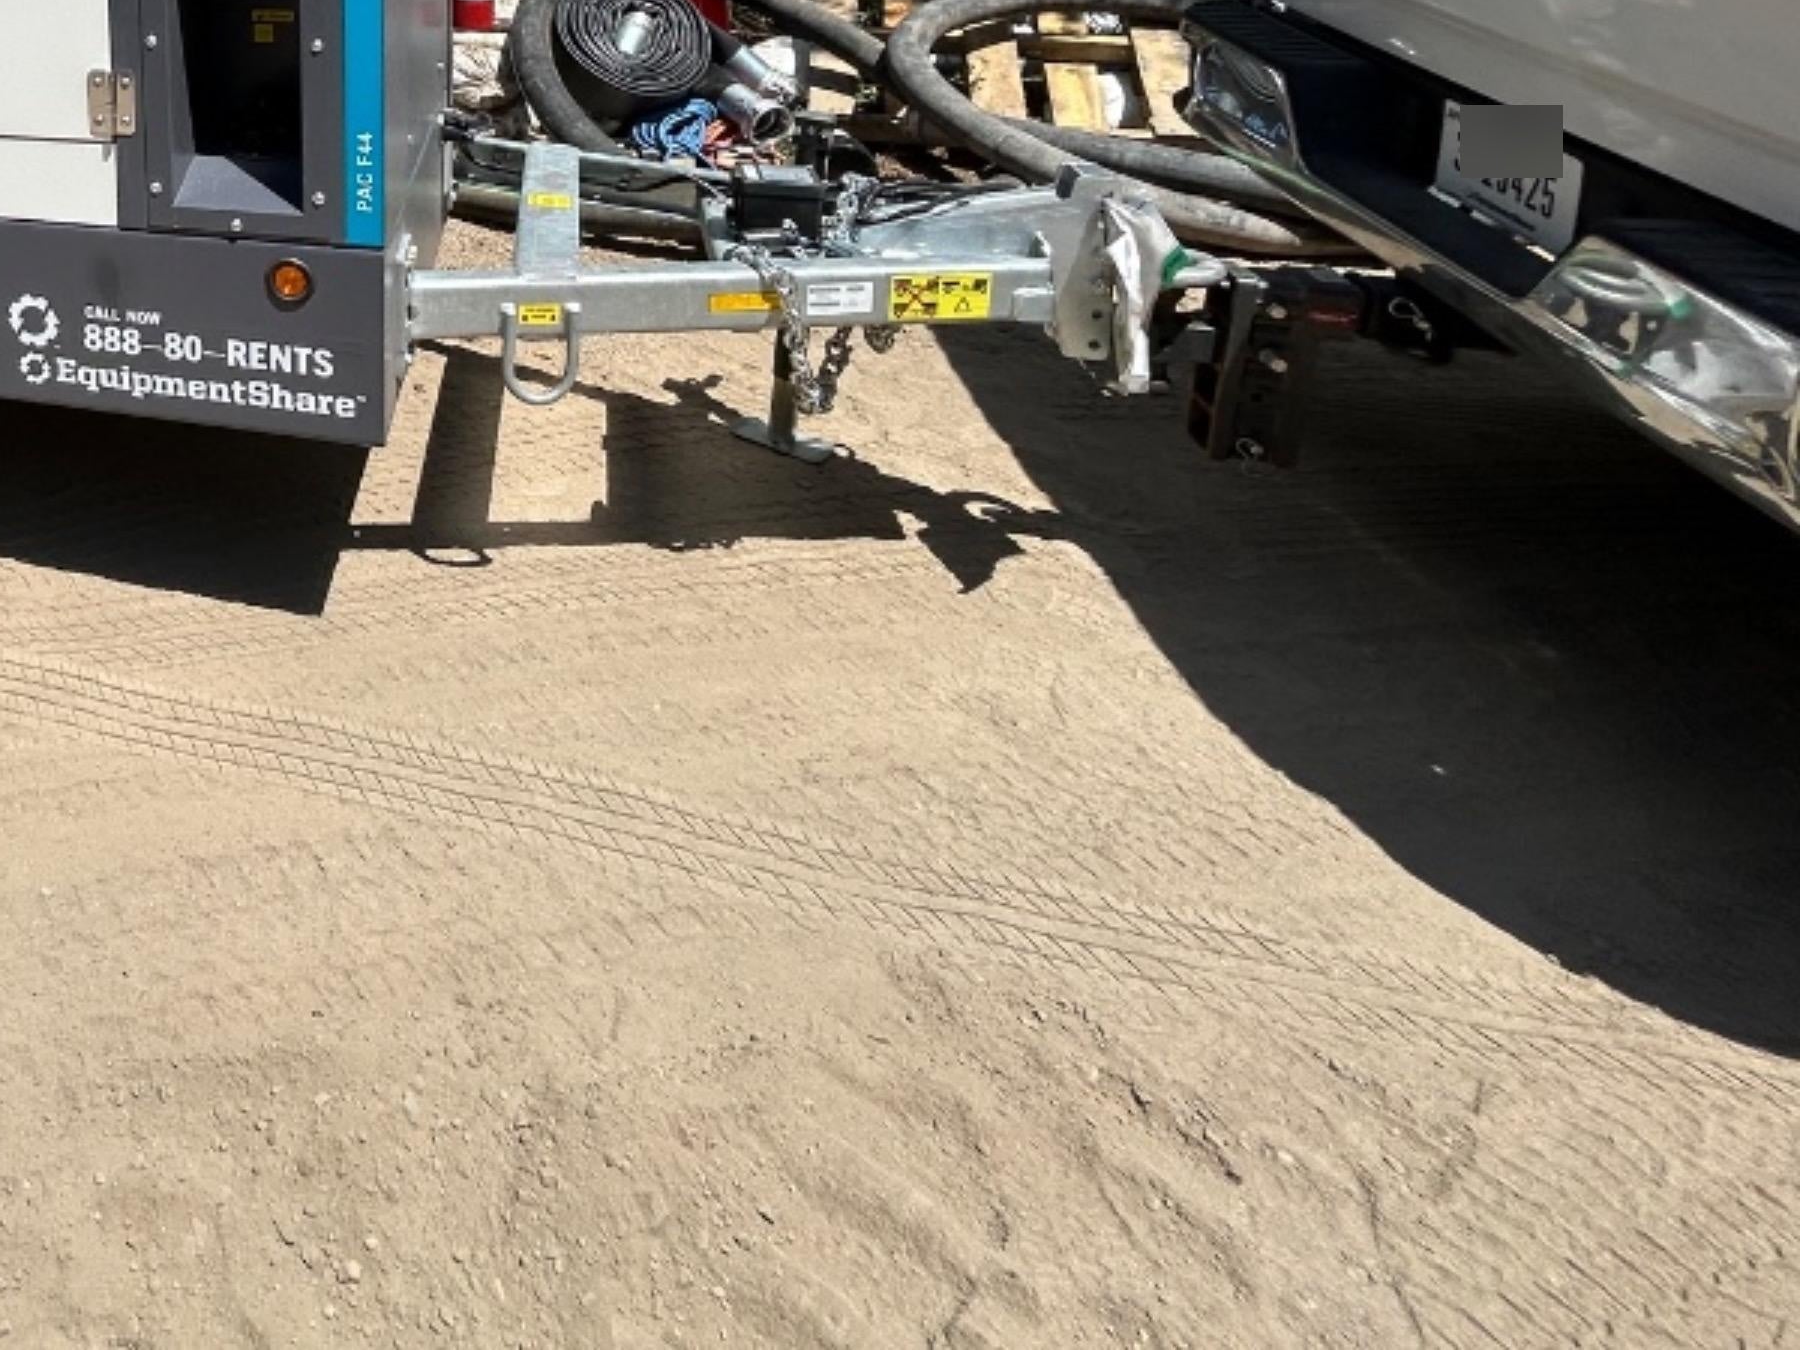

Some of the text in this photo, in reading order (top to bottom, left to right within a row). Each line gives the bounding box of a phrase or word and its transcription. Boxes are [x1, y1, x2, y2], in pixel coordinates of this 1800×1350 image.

[356, 172, 374, 214] PAC
[83, 304, 162, 326] CALL NOW
[55, 356, 356, 419] EquipmentShare
